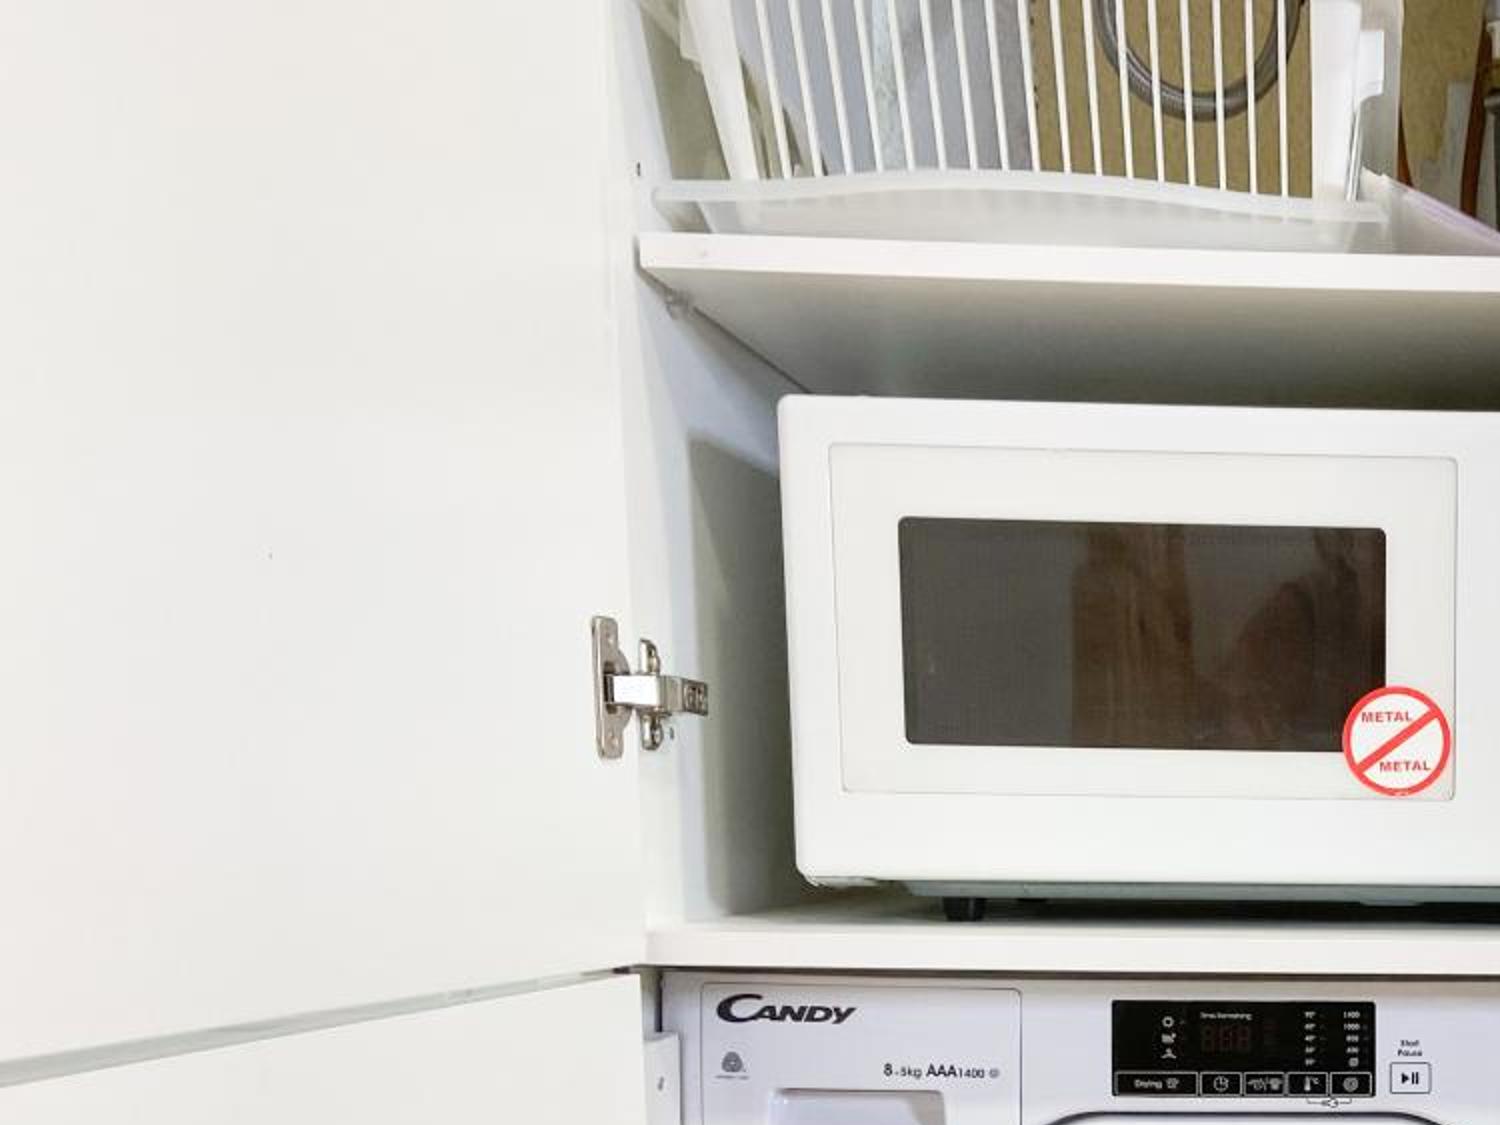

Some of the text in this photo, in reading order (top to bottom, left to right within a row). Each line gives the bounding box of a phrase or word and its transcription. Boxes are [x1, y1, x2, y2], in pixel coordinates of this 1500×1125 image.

[1361, 711, 1412, 722] METAL
[1380, 761, 1431, 772] METAL
[926, 1063, 957, 1077] AAA
